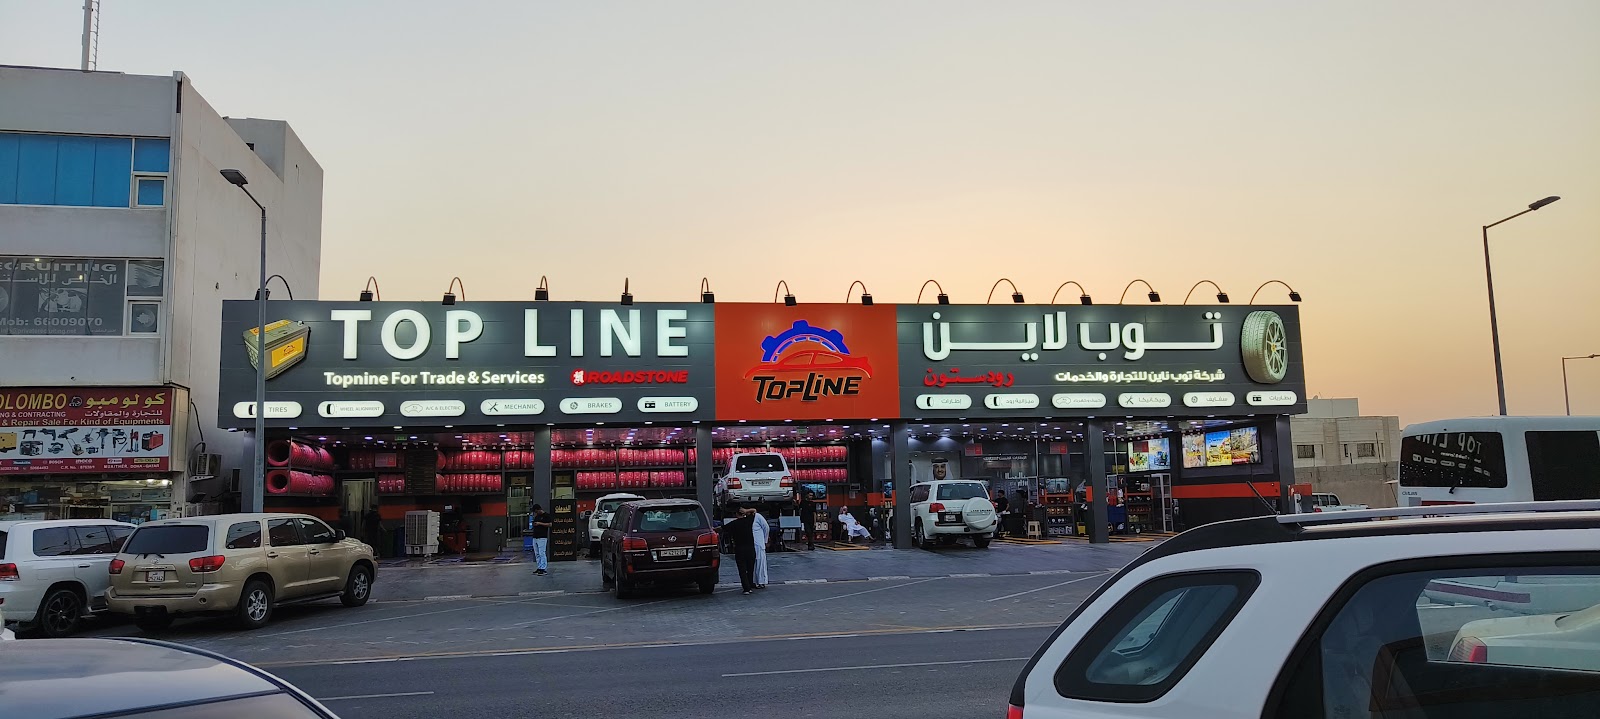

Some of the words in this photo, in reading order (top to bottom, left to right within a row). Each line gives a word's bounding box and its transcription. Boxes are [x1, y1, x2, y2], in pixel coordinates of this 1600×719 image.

[34, 317, 103, 326] 66009070
[331, 309, 484, 360] TOP
[524, 308, 689, 357] LINE
[923, 311, 1068, 361] لاين
[1080, 311, 1224, 361] توب
[323, 371, 389, 389] Topnine
[391, 371, 418, 386] For
[420, 370, 466, 385] Trade
[467, 370, 479, 385] &
[481, 370, 545, 384] Services
[586, 370, 689, 384] ROADSTONE
[923, 367, 1014, 388] رودستون
[1055, 371, 1109, 383] والخدمات
[1109, 370, 1147, 383] للتجارة
[1147, 370, 1170, 383] ناين
[1170, 370, 1193, 383] توب
[1194, 368, 1225, 382] شركة
[504, 403, 538, 411] MECHANIC
[11, 419, 40, 427] Repair
[80, 418, 101, 426] Kind
[113, 418, 165, 426] Equipments
